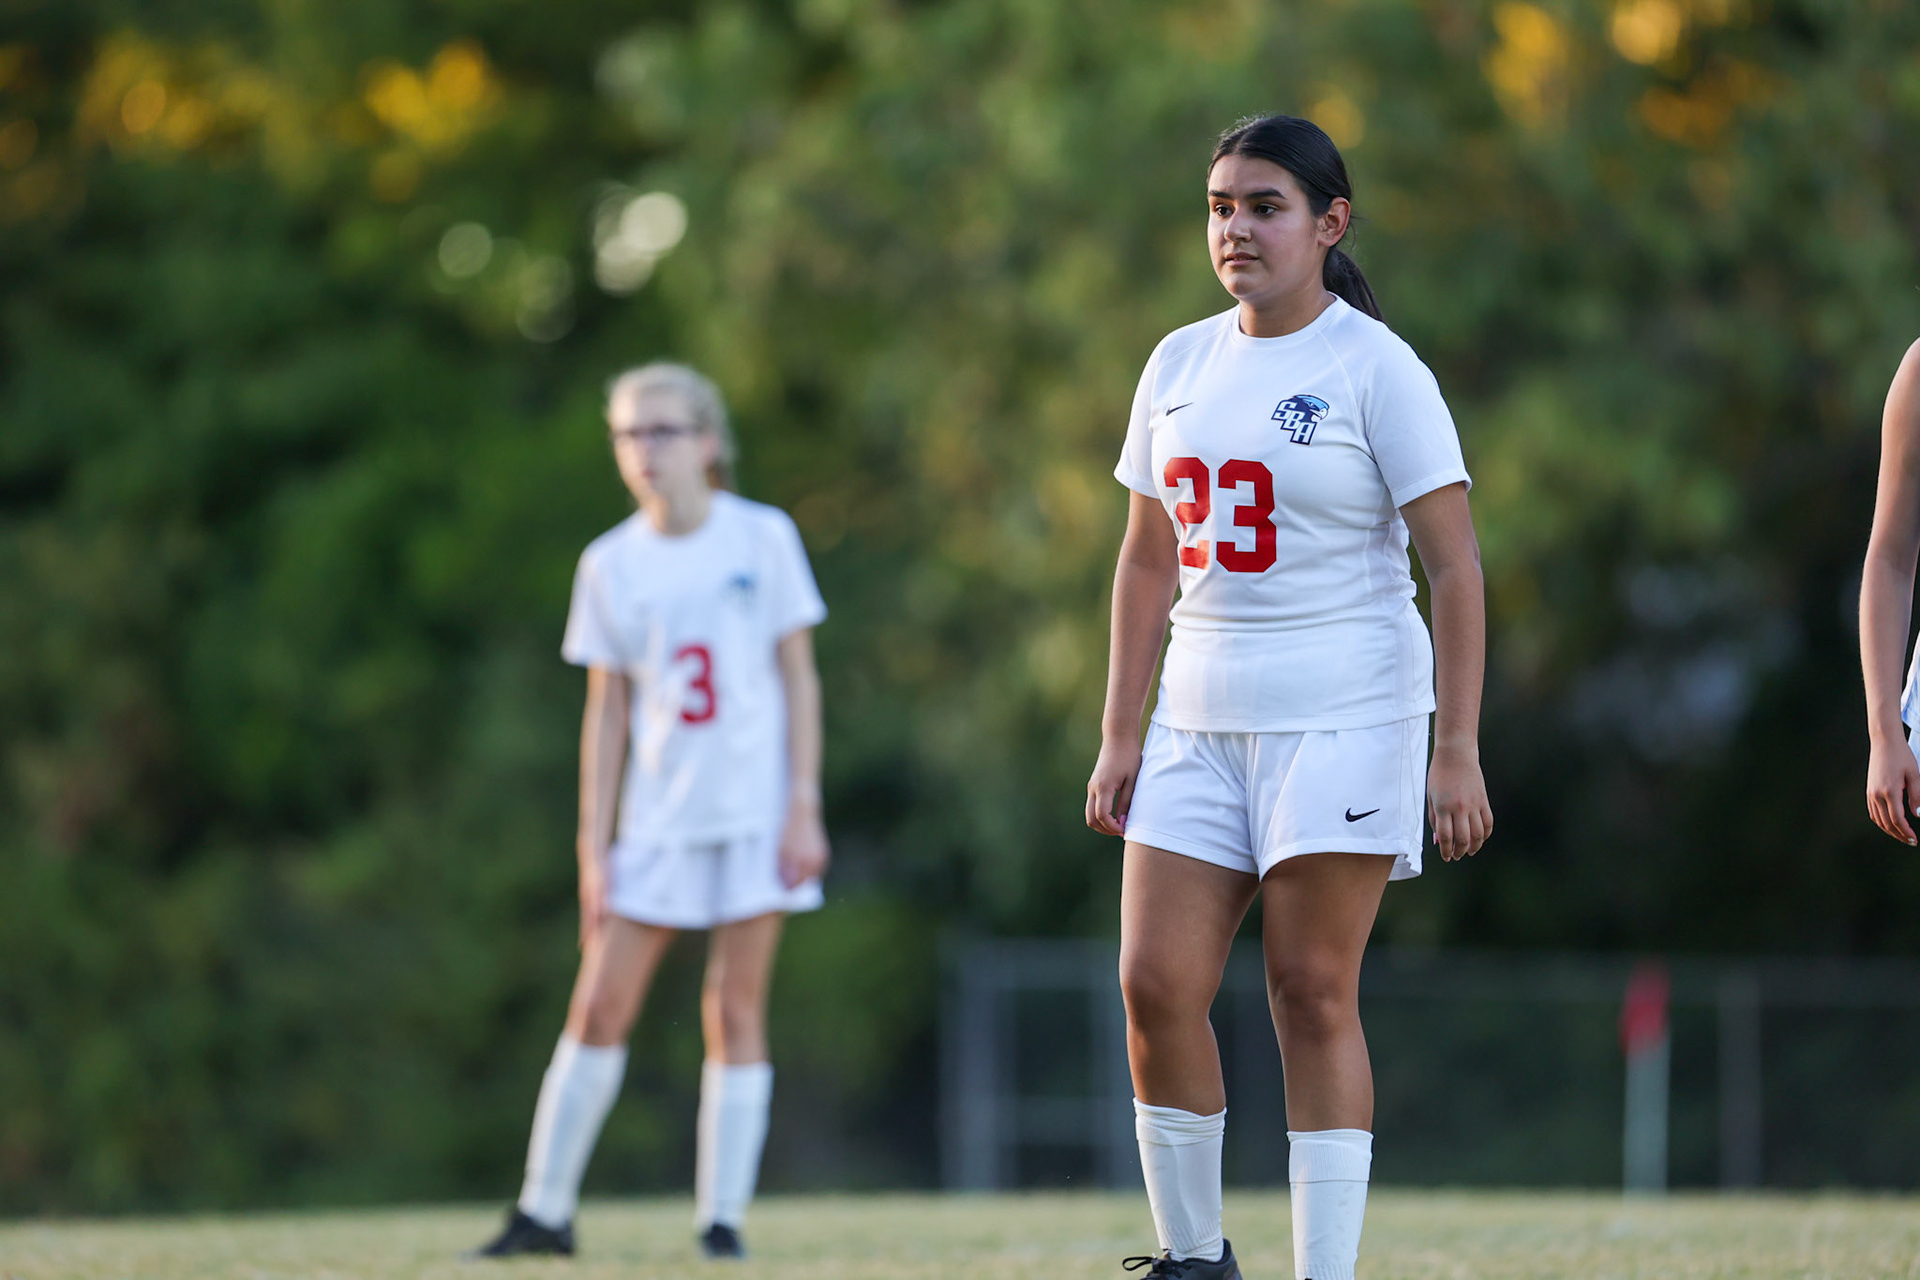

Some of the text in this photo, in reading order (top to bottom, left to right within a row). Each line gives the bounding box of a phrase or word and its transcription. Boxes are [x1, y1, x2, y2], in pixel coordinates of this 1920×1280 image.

[1272, 400, 1317, 445] SBA
[1163, 457, 1277, 573] 23
[673, 643, 717, 726] 3
